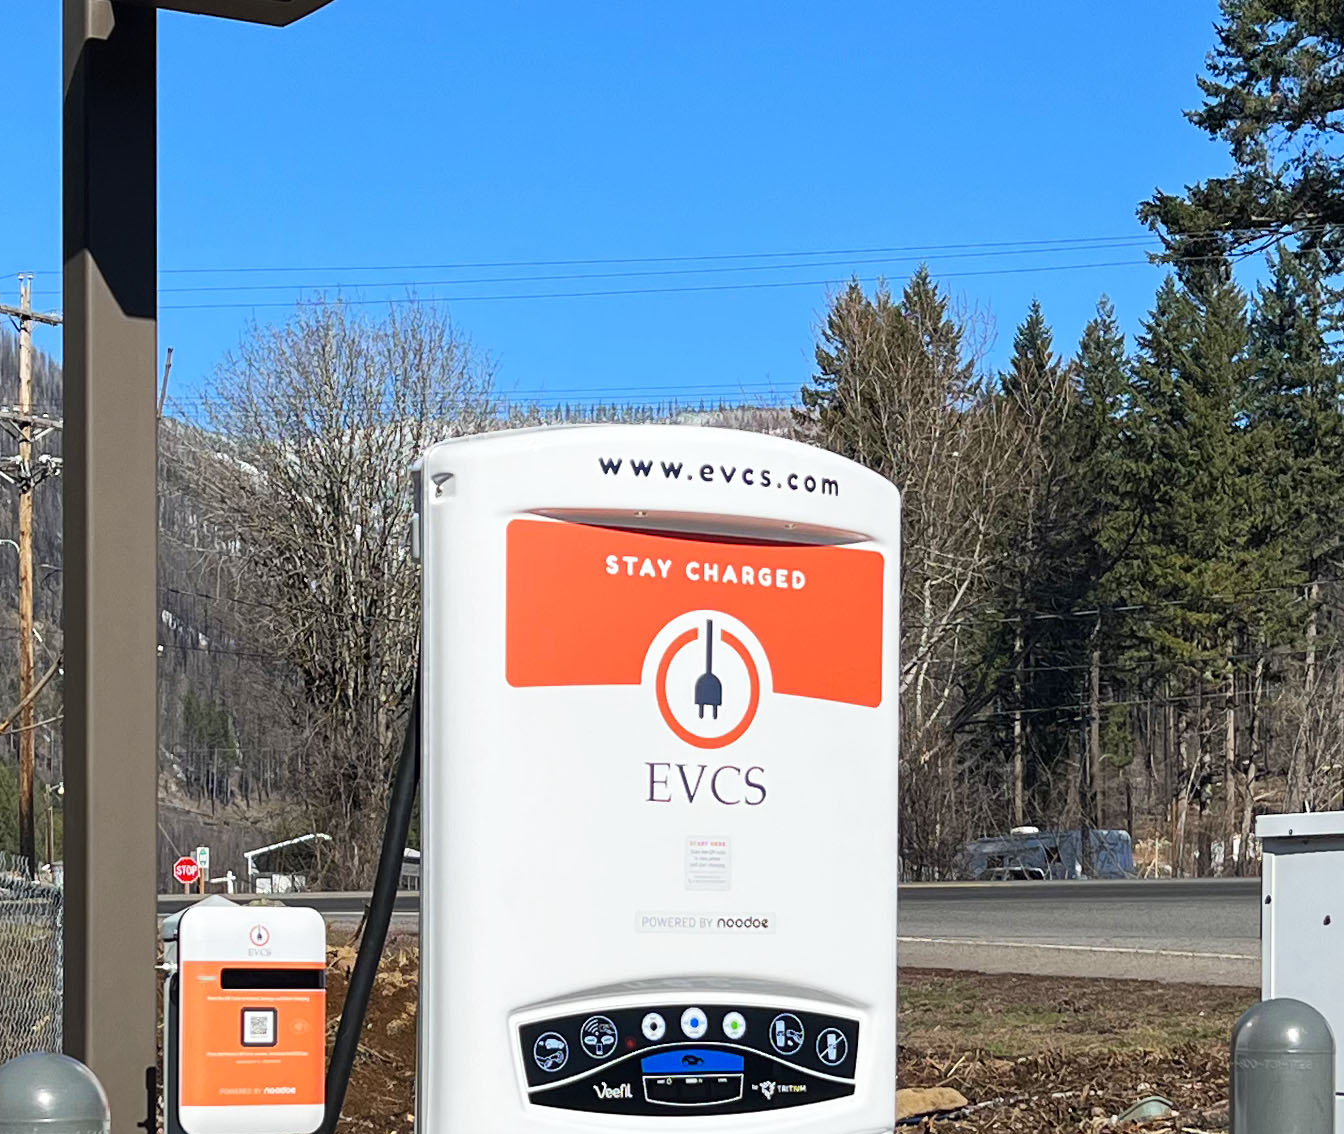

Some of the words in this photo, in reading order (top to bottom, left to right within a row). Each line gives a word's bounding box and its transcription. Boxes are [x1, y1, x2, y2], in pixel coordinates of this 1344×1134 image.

[598, 456, 841, 497] www.evcs.com
[605, 554, 673, 579] STAY
[686, 561, 807, 590] CHARGED
[644, 761, 768, 806] EVCS
[176, 865, 198, 876] STOP
[641, 916, 697, 929] POWERED
[699, 917, 713, 928] BY
[717, 916, 769, 929] noodoe
[593, 1081, 634, 1099] Veefil
